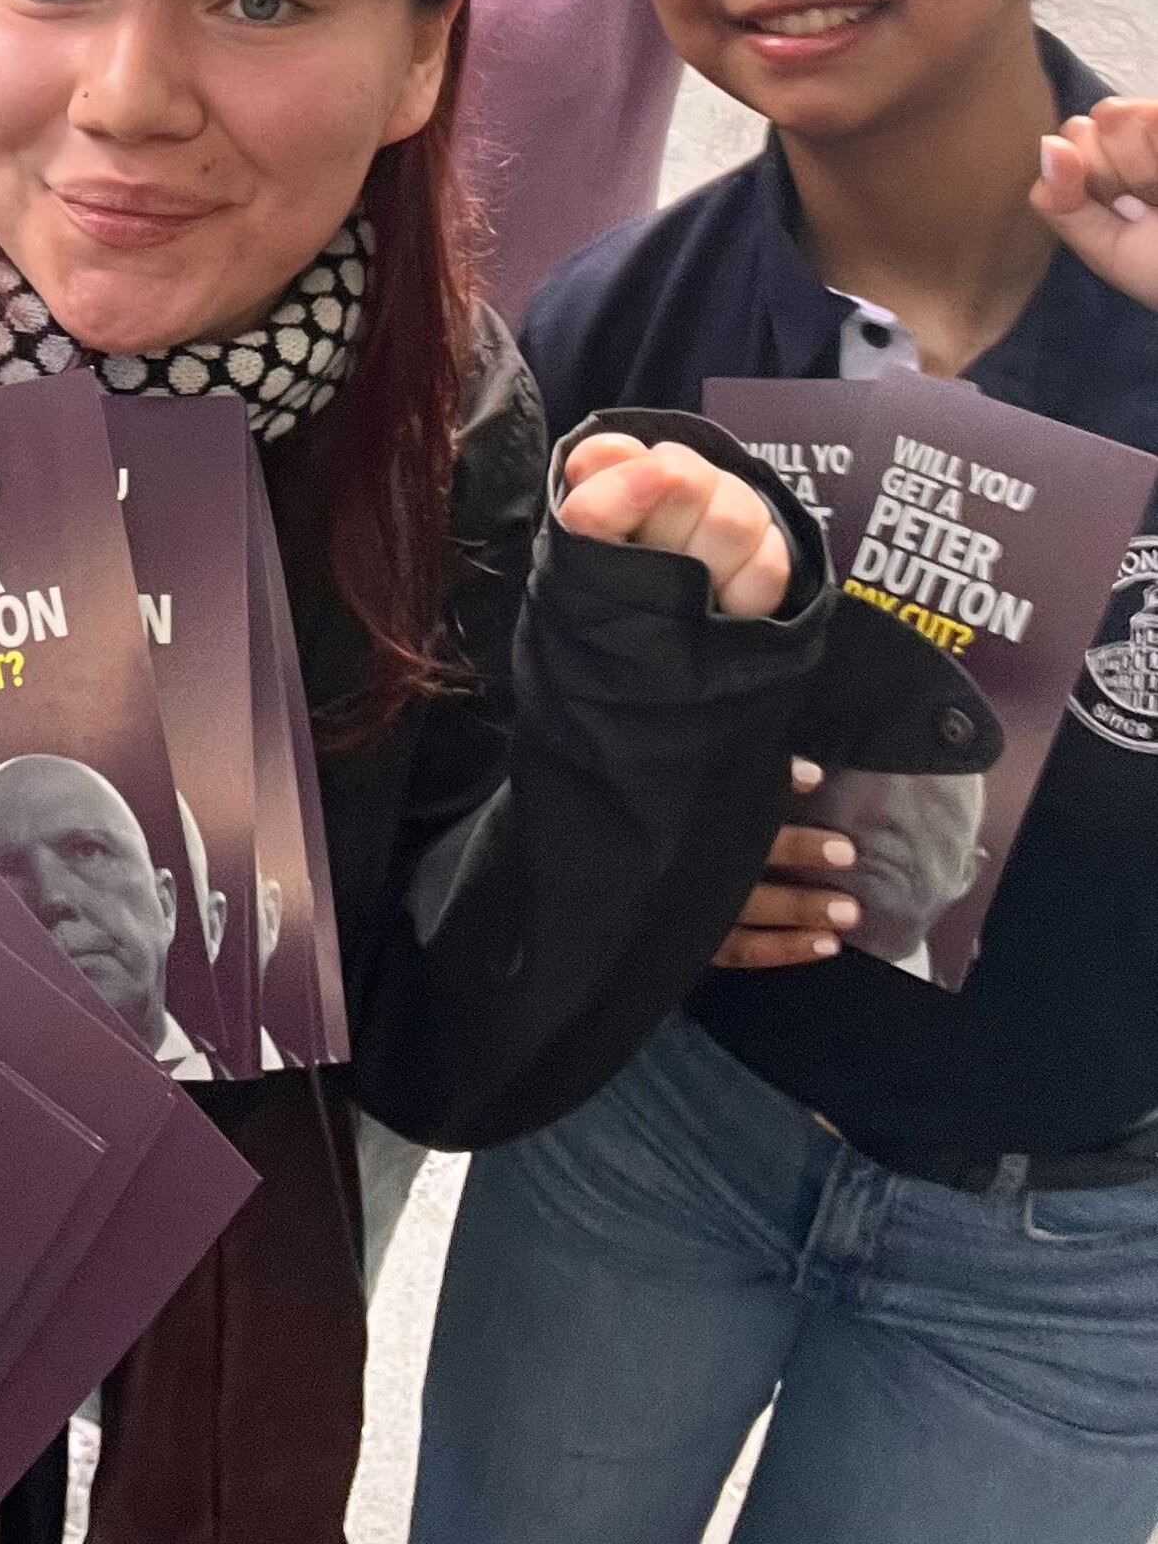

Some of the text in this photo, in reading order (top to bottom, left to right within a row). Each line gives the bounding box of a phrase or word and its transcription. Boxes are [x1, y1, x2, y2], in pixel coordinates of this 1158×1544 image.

[811, 444, 853, 474] YO
[881, 466, 964, 521] GET A
[893, 435, 1037, 512] WILL YOU
[866, 494, 1003, 582] PETER
[850, 536, 1033, 643] DUTTON
